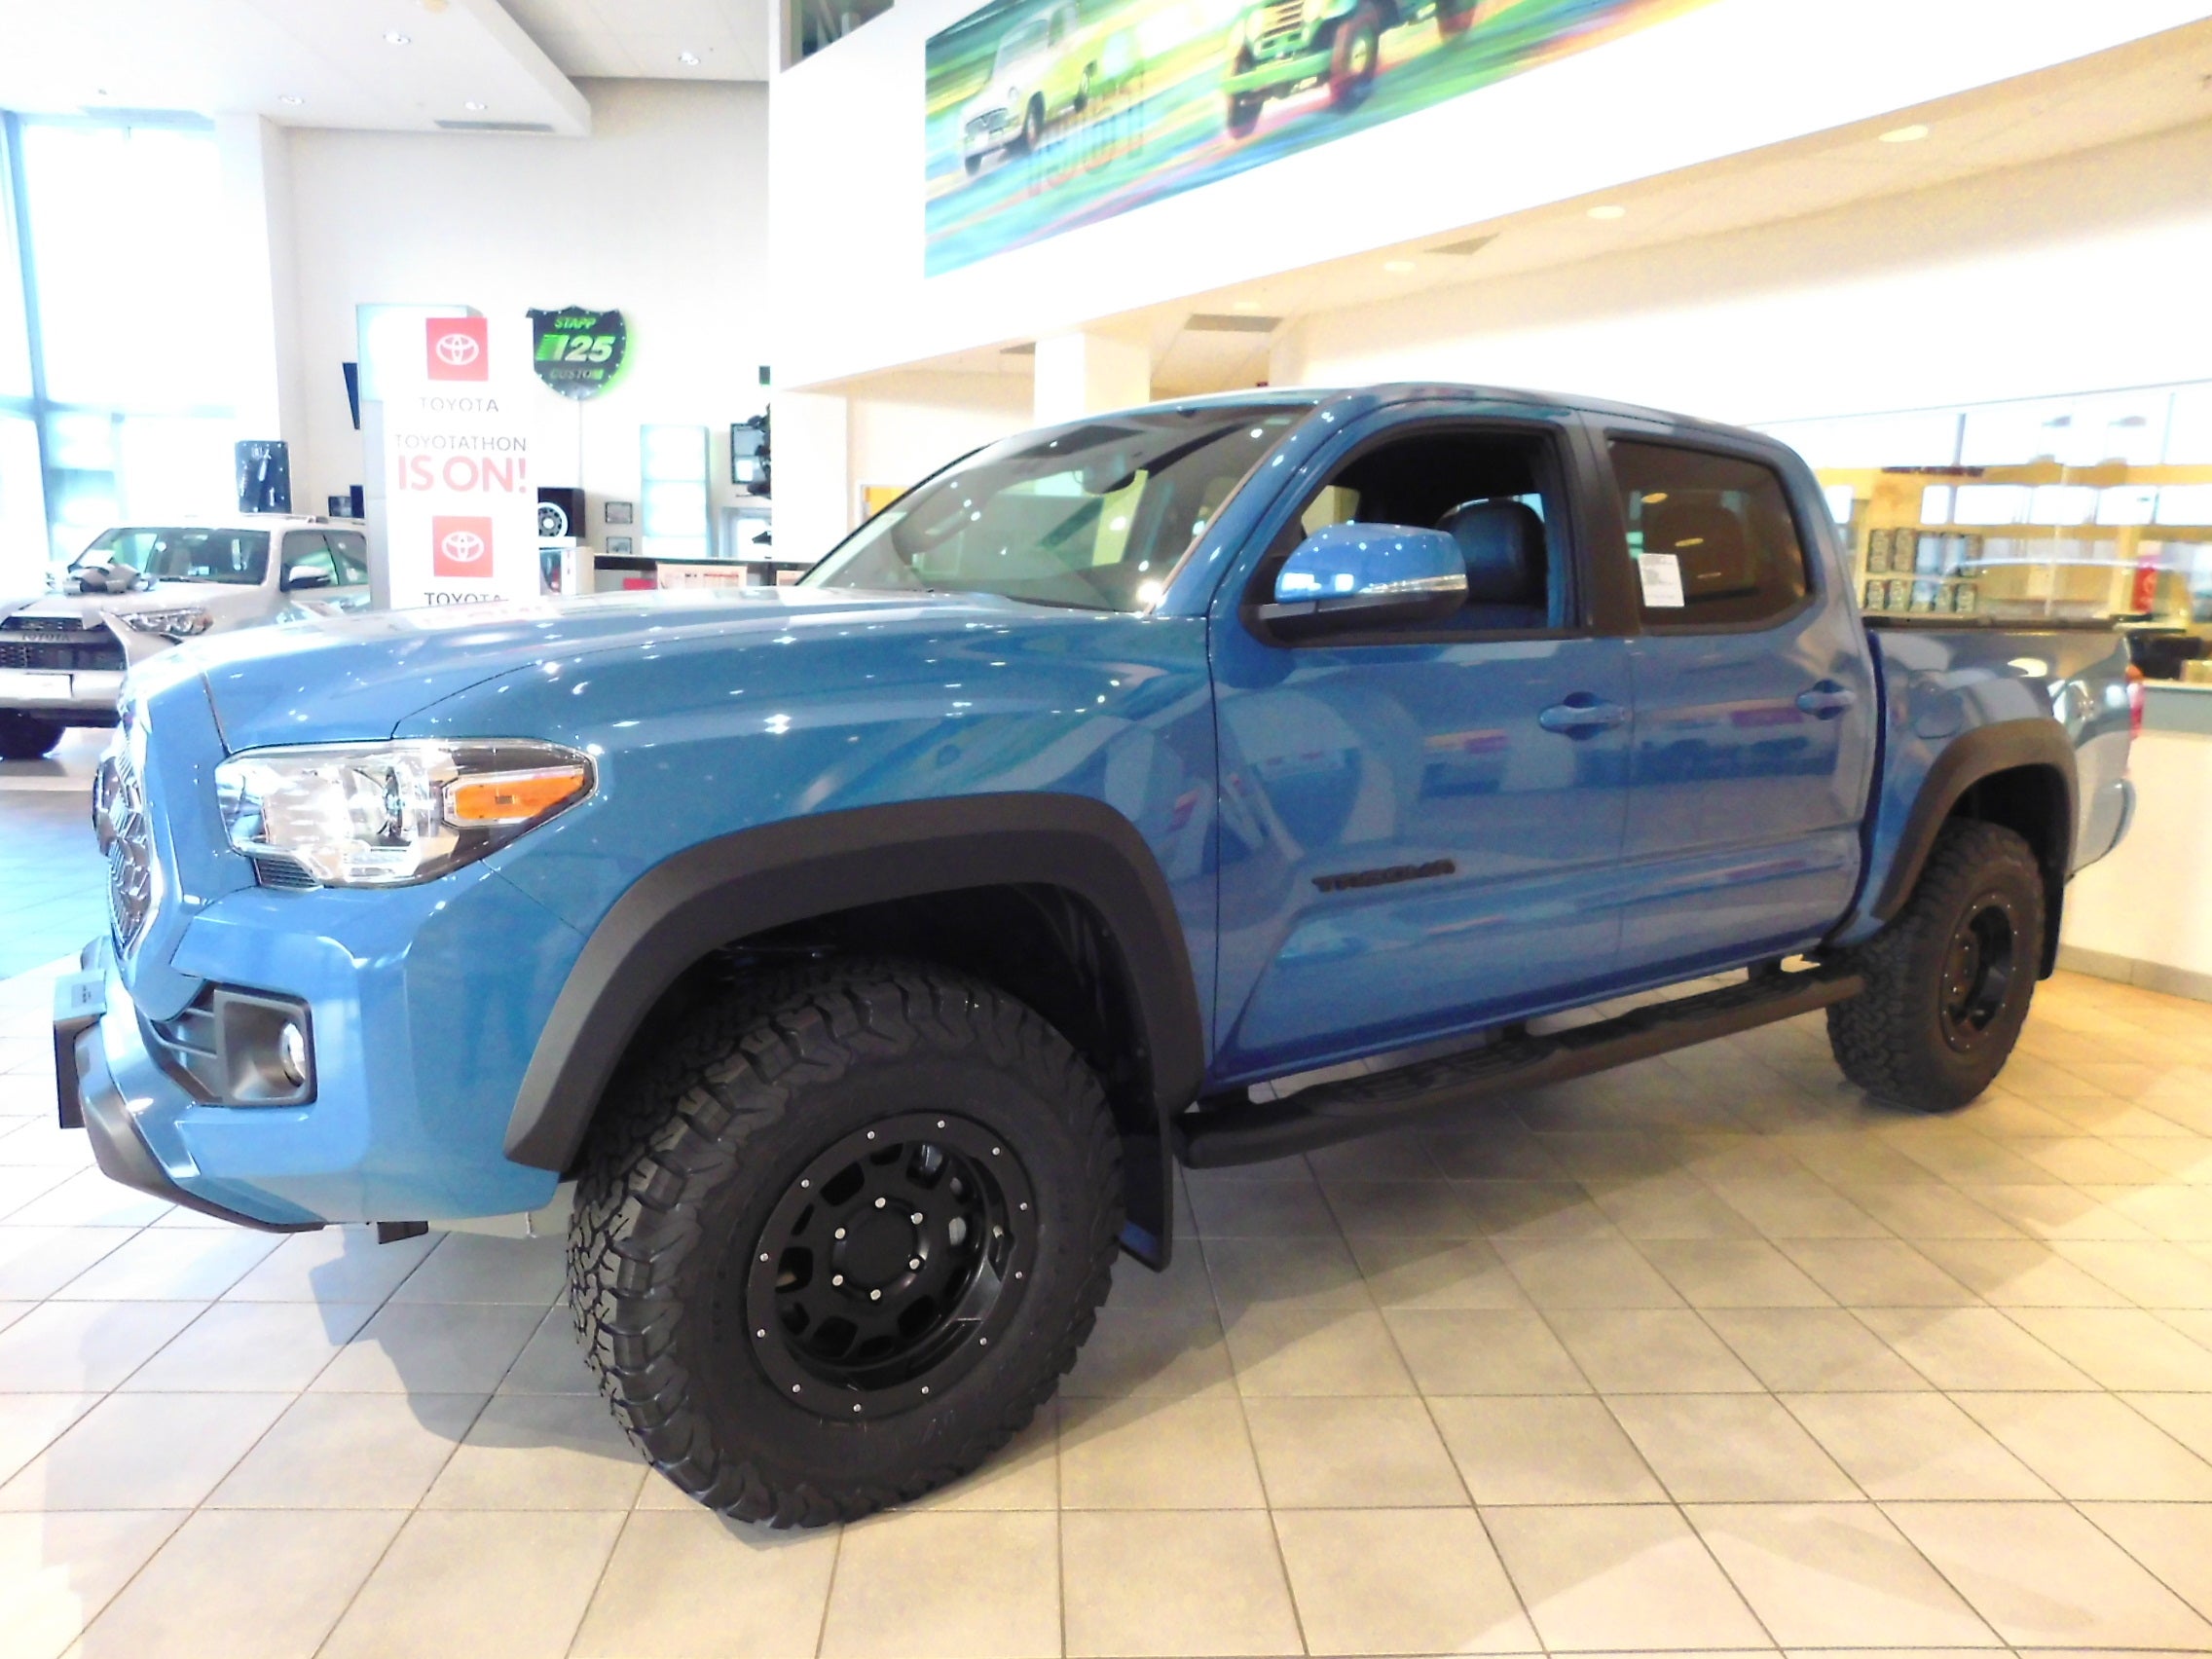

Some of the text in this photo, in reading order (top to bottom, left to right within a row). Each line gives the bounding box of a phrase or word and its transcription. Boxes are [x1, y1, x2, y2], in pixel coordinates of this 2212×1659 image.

[554, 316, 597, 329] STAPP
[420, 396, 499, 413] TOYOTA
[395, 434, 527, 452] TOYOTATHON
[397, 455, 527, 494] IS ON!
[20, 633, 71, 642] TOYOTA
